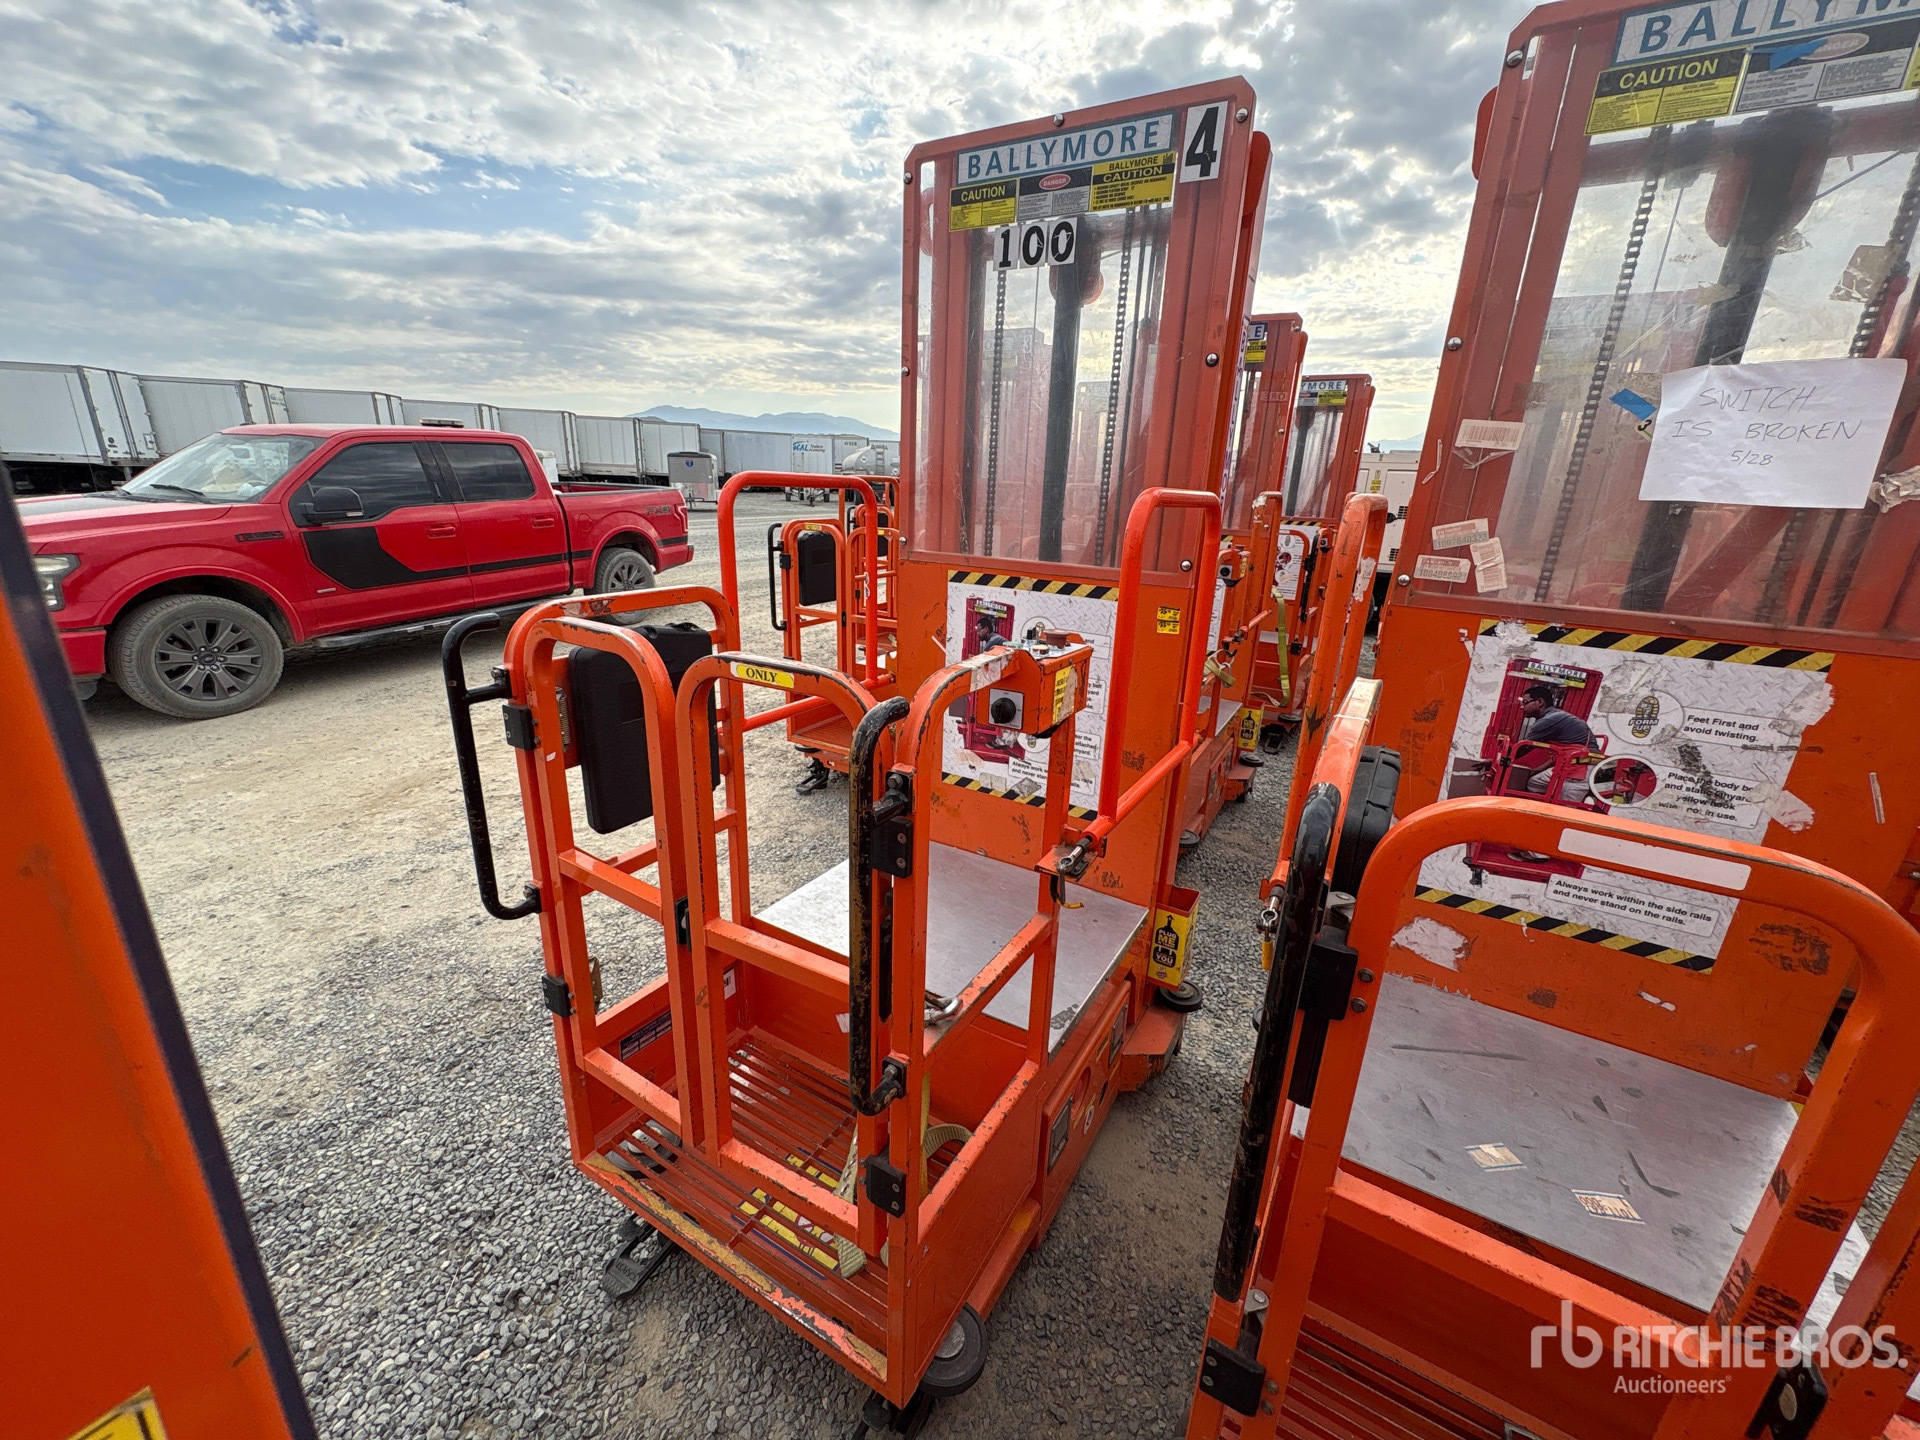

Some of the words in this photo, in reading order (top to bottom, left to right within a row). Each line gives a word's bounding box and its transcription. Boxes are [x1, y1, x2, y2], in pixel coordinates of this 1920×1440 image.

[1619, 58, 1719, 89] CAUTION
[1185, 106, 1220, 177] 4
[967, 120, 1160, 180] BALLYMORE
[1109, 156, 1159, 171] BALLYMORE
[1043, 177, 1067, 187] DANGER
[1103, 166, 1163, 183] CAUTION
[960, 185, 1006, 202] CAUTION
[998, 221, 1075, 268] 100
[1699, 386, 1817, 413] SWITCH
[1672, 419, 1713, 438] IS
[1745, 419, 1863, 443] BROKEN
[1730, 450, 1774, 466] 5/28
[745, 667, 778, 683] ONLY
[1529, 662, 1585, 679] BALLYMORE
[1628, 718, 1660, 726] FORM
[1635, 724, 1650, 732] UP
[1686, 715, 1710, 724] Feet
[1711, 718, 1737, 728] First
[1738, 723, 1760, 731] and
[1683, 726, 1713, 735] avoid
[1714, 729, 1759, 743] twisting.
[1664, 783, 1683, 791] and
[1685, 784, 1713, 797] static
[1667, 772, 1695, 783] Place
[1696, 776, 1713, 786] the
[1714, 780, 1739, 792] body
[1676, 795, 1708, 806] yellow
[1709, 801, 1736, 810] hook
[1705, 809, 1715, 817] in
[1716, 813, 1738, 821] use.
[1552, 888, 1571, 898] and
[1572, 893, 1599, 904] never
[1600, 899, 1628, 912] stand
[1629, 906, 1642, 915] on
[1644, 909, 1660, 919] the
[1662, 915, 1686, 926] rails.
[1555, 879, 1589, 893] Always
[1591, 888, 1614, 899] work
[1616, 893, 1646, 907] within
[1648, 901, 1664, 911] the
[1666, 905, 1688, 916] side
[1689, 911, 1712, 922] rails
[1158, 929, 1177, 939] PLUG
[1159, 934, 1176, 945] ME
[1156, 953, 1173, 964] YOU
